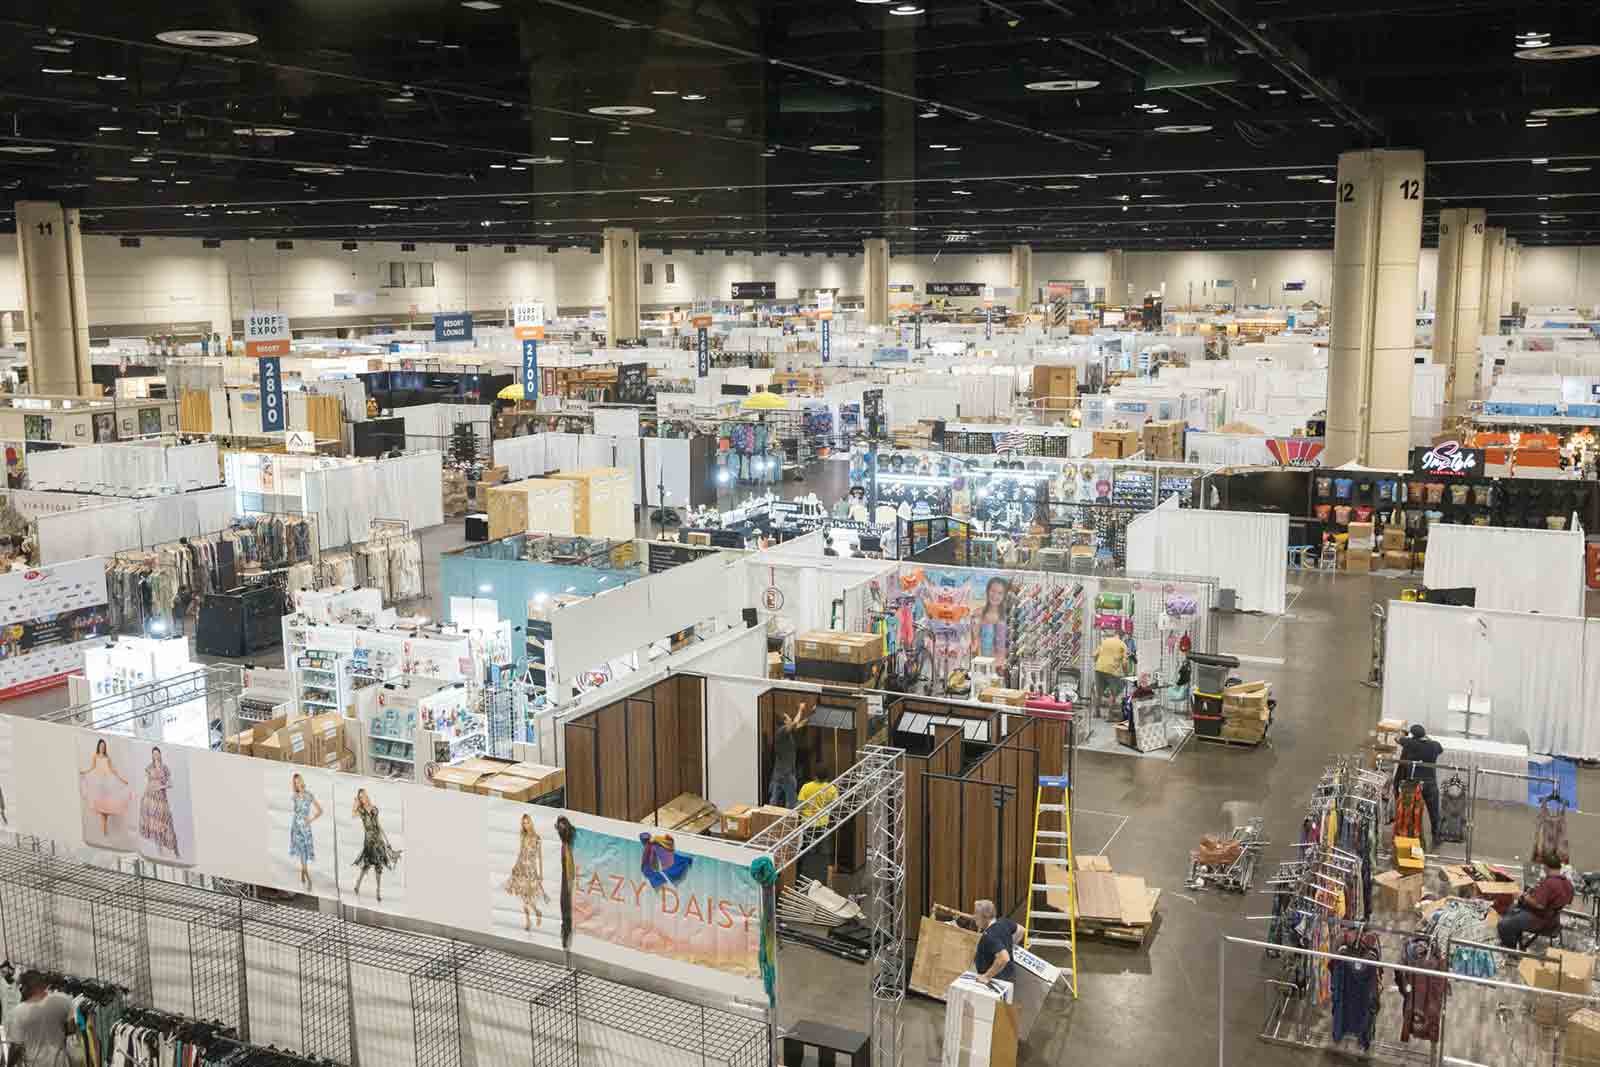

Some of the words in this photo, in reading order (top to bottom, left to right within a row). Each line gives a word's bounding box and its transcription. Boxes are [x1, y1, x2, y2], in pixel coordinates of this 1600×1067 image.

[1338, 183, 1355, 203] 12
[1399, 180, 1420, 200] 12
[36, 222, 52, 235] 11
[1472, 224, 1484, 234] 10
[250, 316, 277, 326] SURF
[443, 319, 465, 328] RESORT
[251, 326, 278, 335] EXPO
[526, 344, 535, 393] 2700
[264, 362, 279, 423] 2800
[661, 886, 756, 931] DAISY
